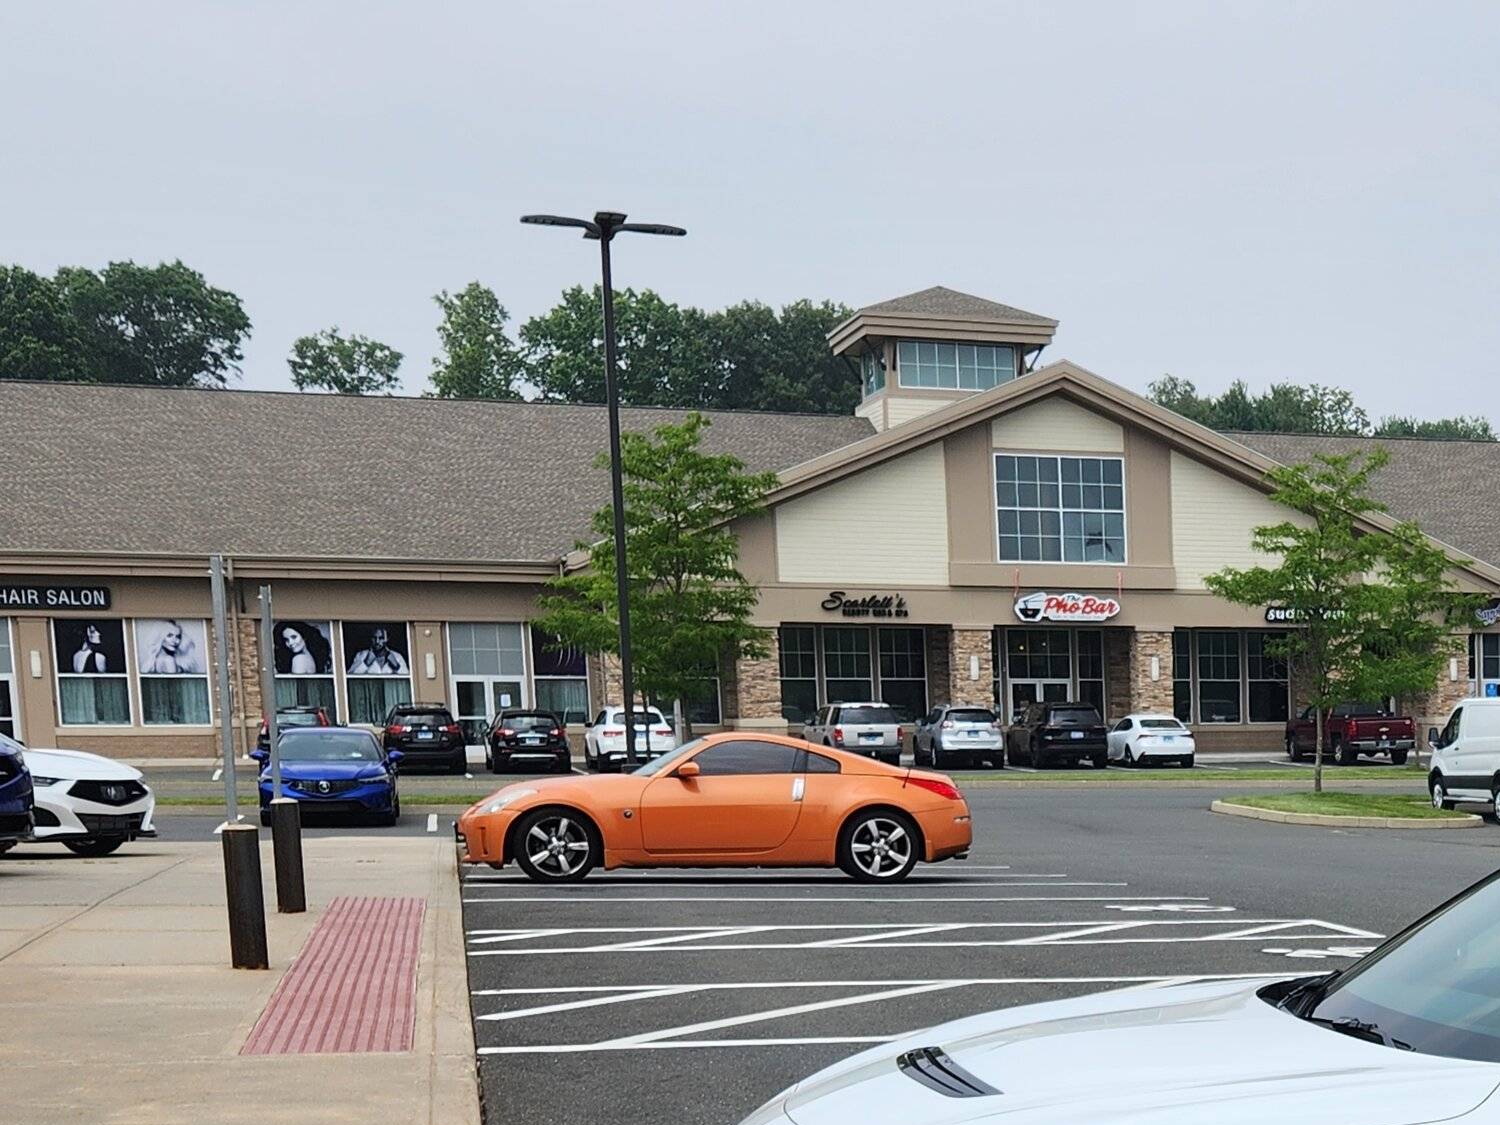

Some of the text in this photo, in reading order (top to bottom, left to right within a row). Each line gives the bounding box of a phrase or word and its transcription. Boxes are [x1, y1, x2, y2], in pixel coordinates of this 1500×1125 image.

[0, 589, 106, 606] HAIR SALON
[1043, 597, 1119, 615] Pho Bar
